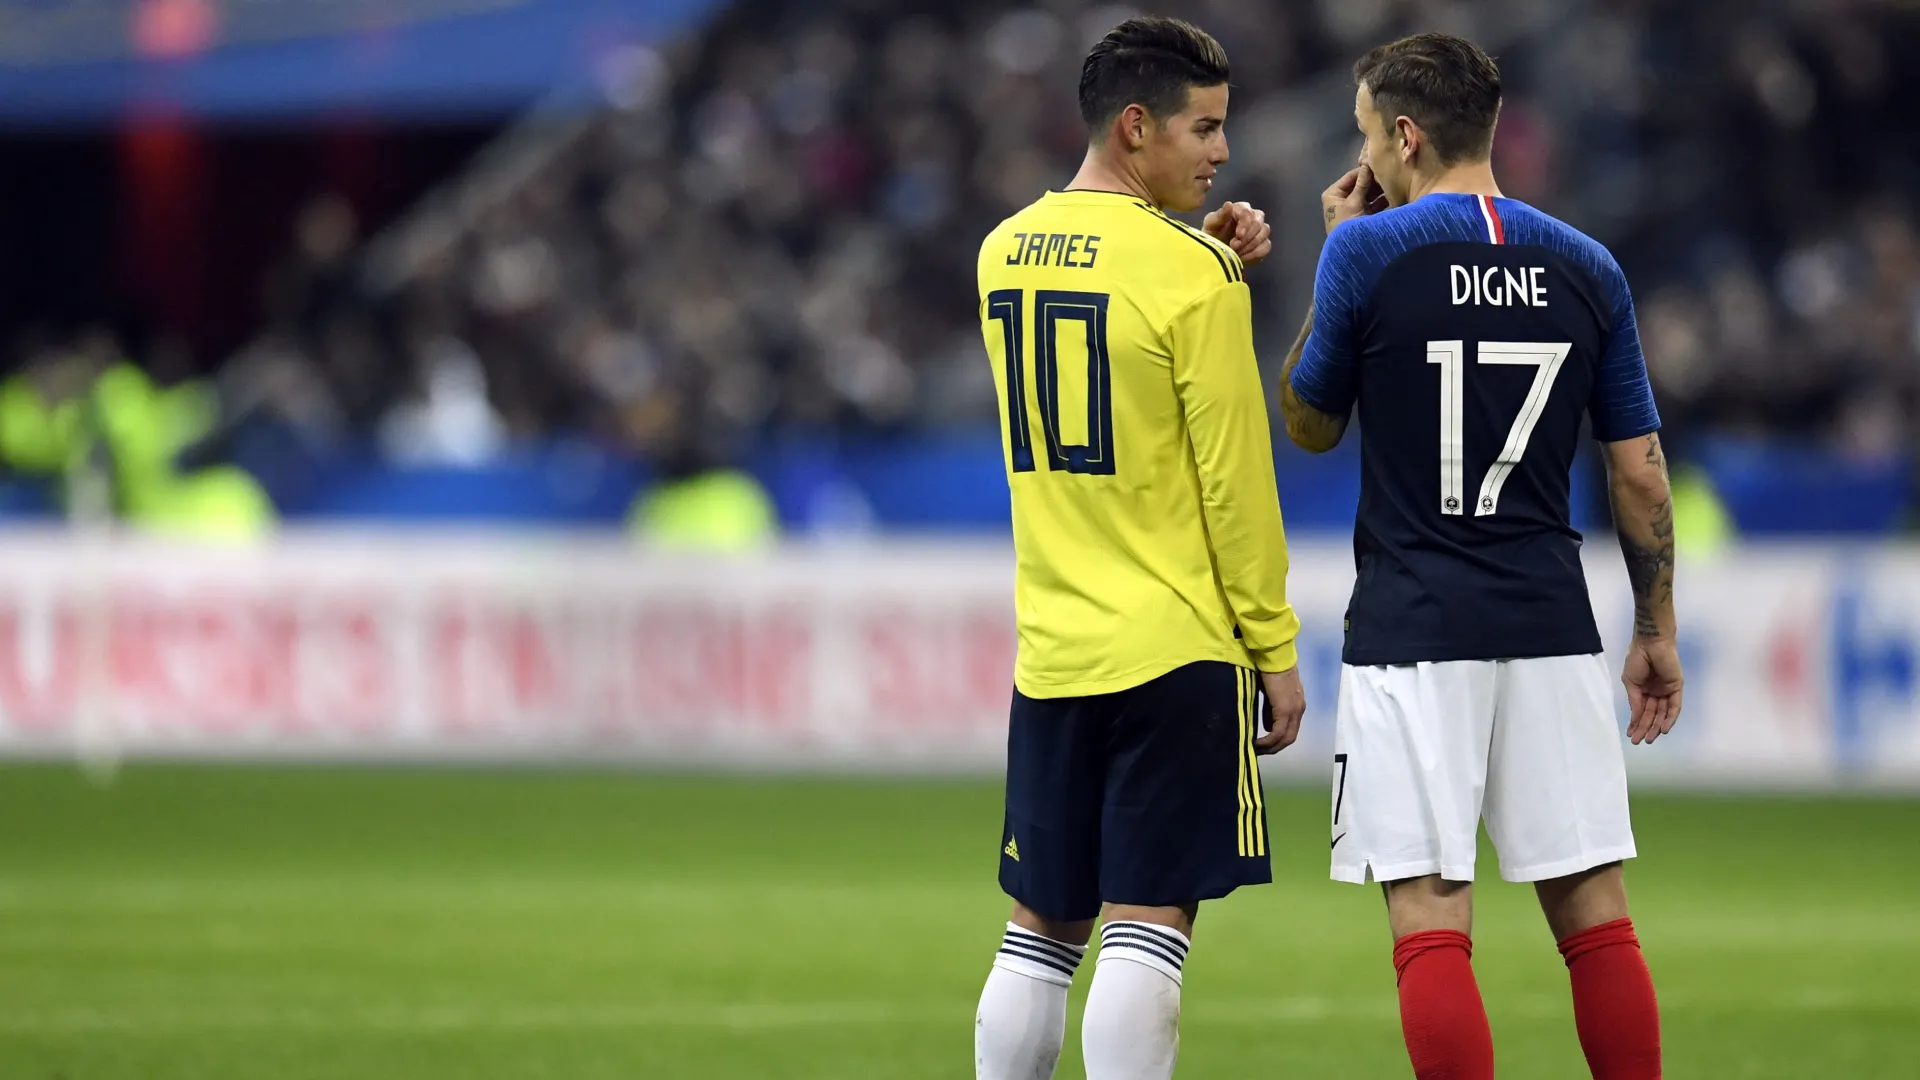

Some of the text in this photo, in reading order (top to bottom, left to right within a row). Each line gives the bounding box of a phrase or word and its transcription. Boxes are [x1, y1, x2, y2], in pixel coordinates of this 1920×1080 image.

[1006, 233, 1101, 268] JAMES
[1450, 264, 1548, 307] DIGNE
[988, 289, 1116, 475] 10
[1426, 340, 1573, 516] 17
